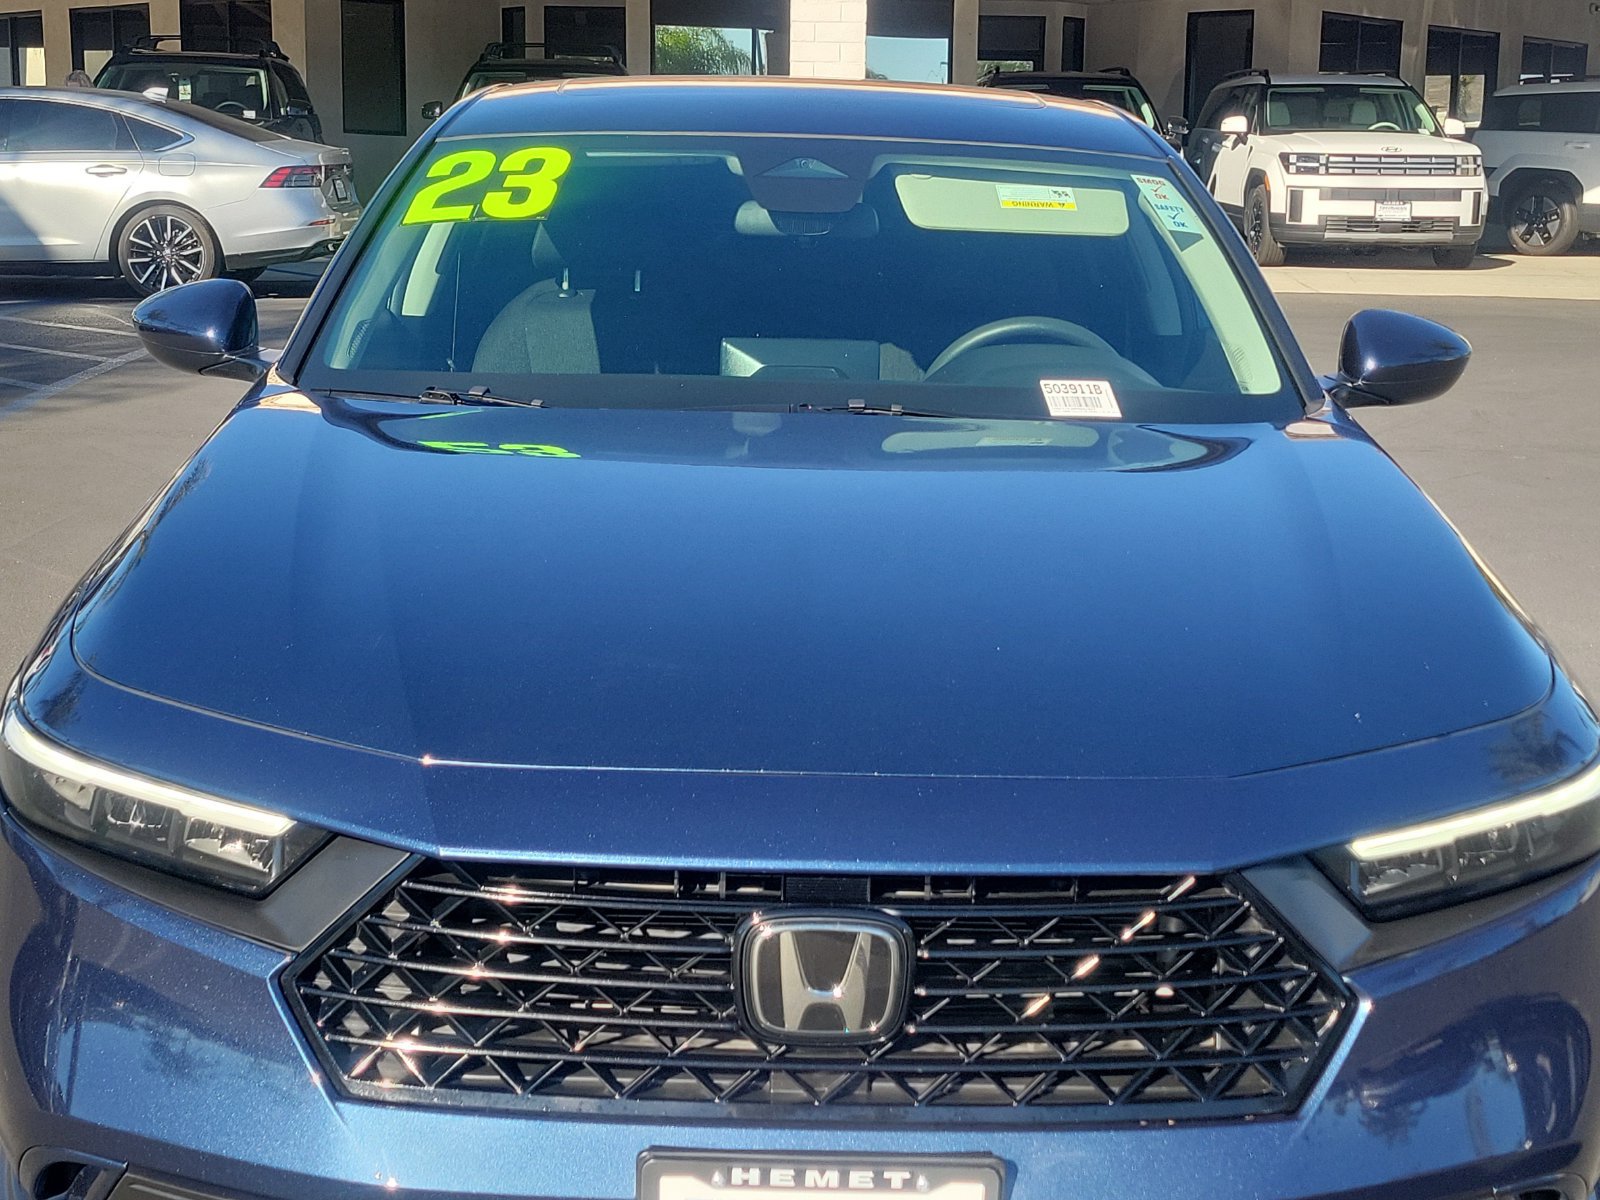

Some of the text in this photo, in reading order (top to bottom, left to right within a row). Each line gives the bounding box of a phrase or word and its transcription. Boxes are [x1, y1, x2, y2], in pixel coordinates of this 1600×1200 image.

[403, 147, 571, 224] 23
[1136, 177, 1165, 186] SMOG
[1154, 203, 1184, 212] SAFETY
[1173, 220, 1188, 228] OK
[730, 1167, 911, 1190] HEMET
